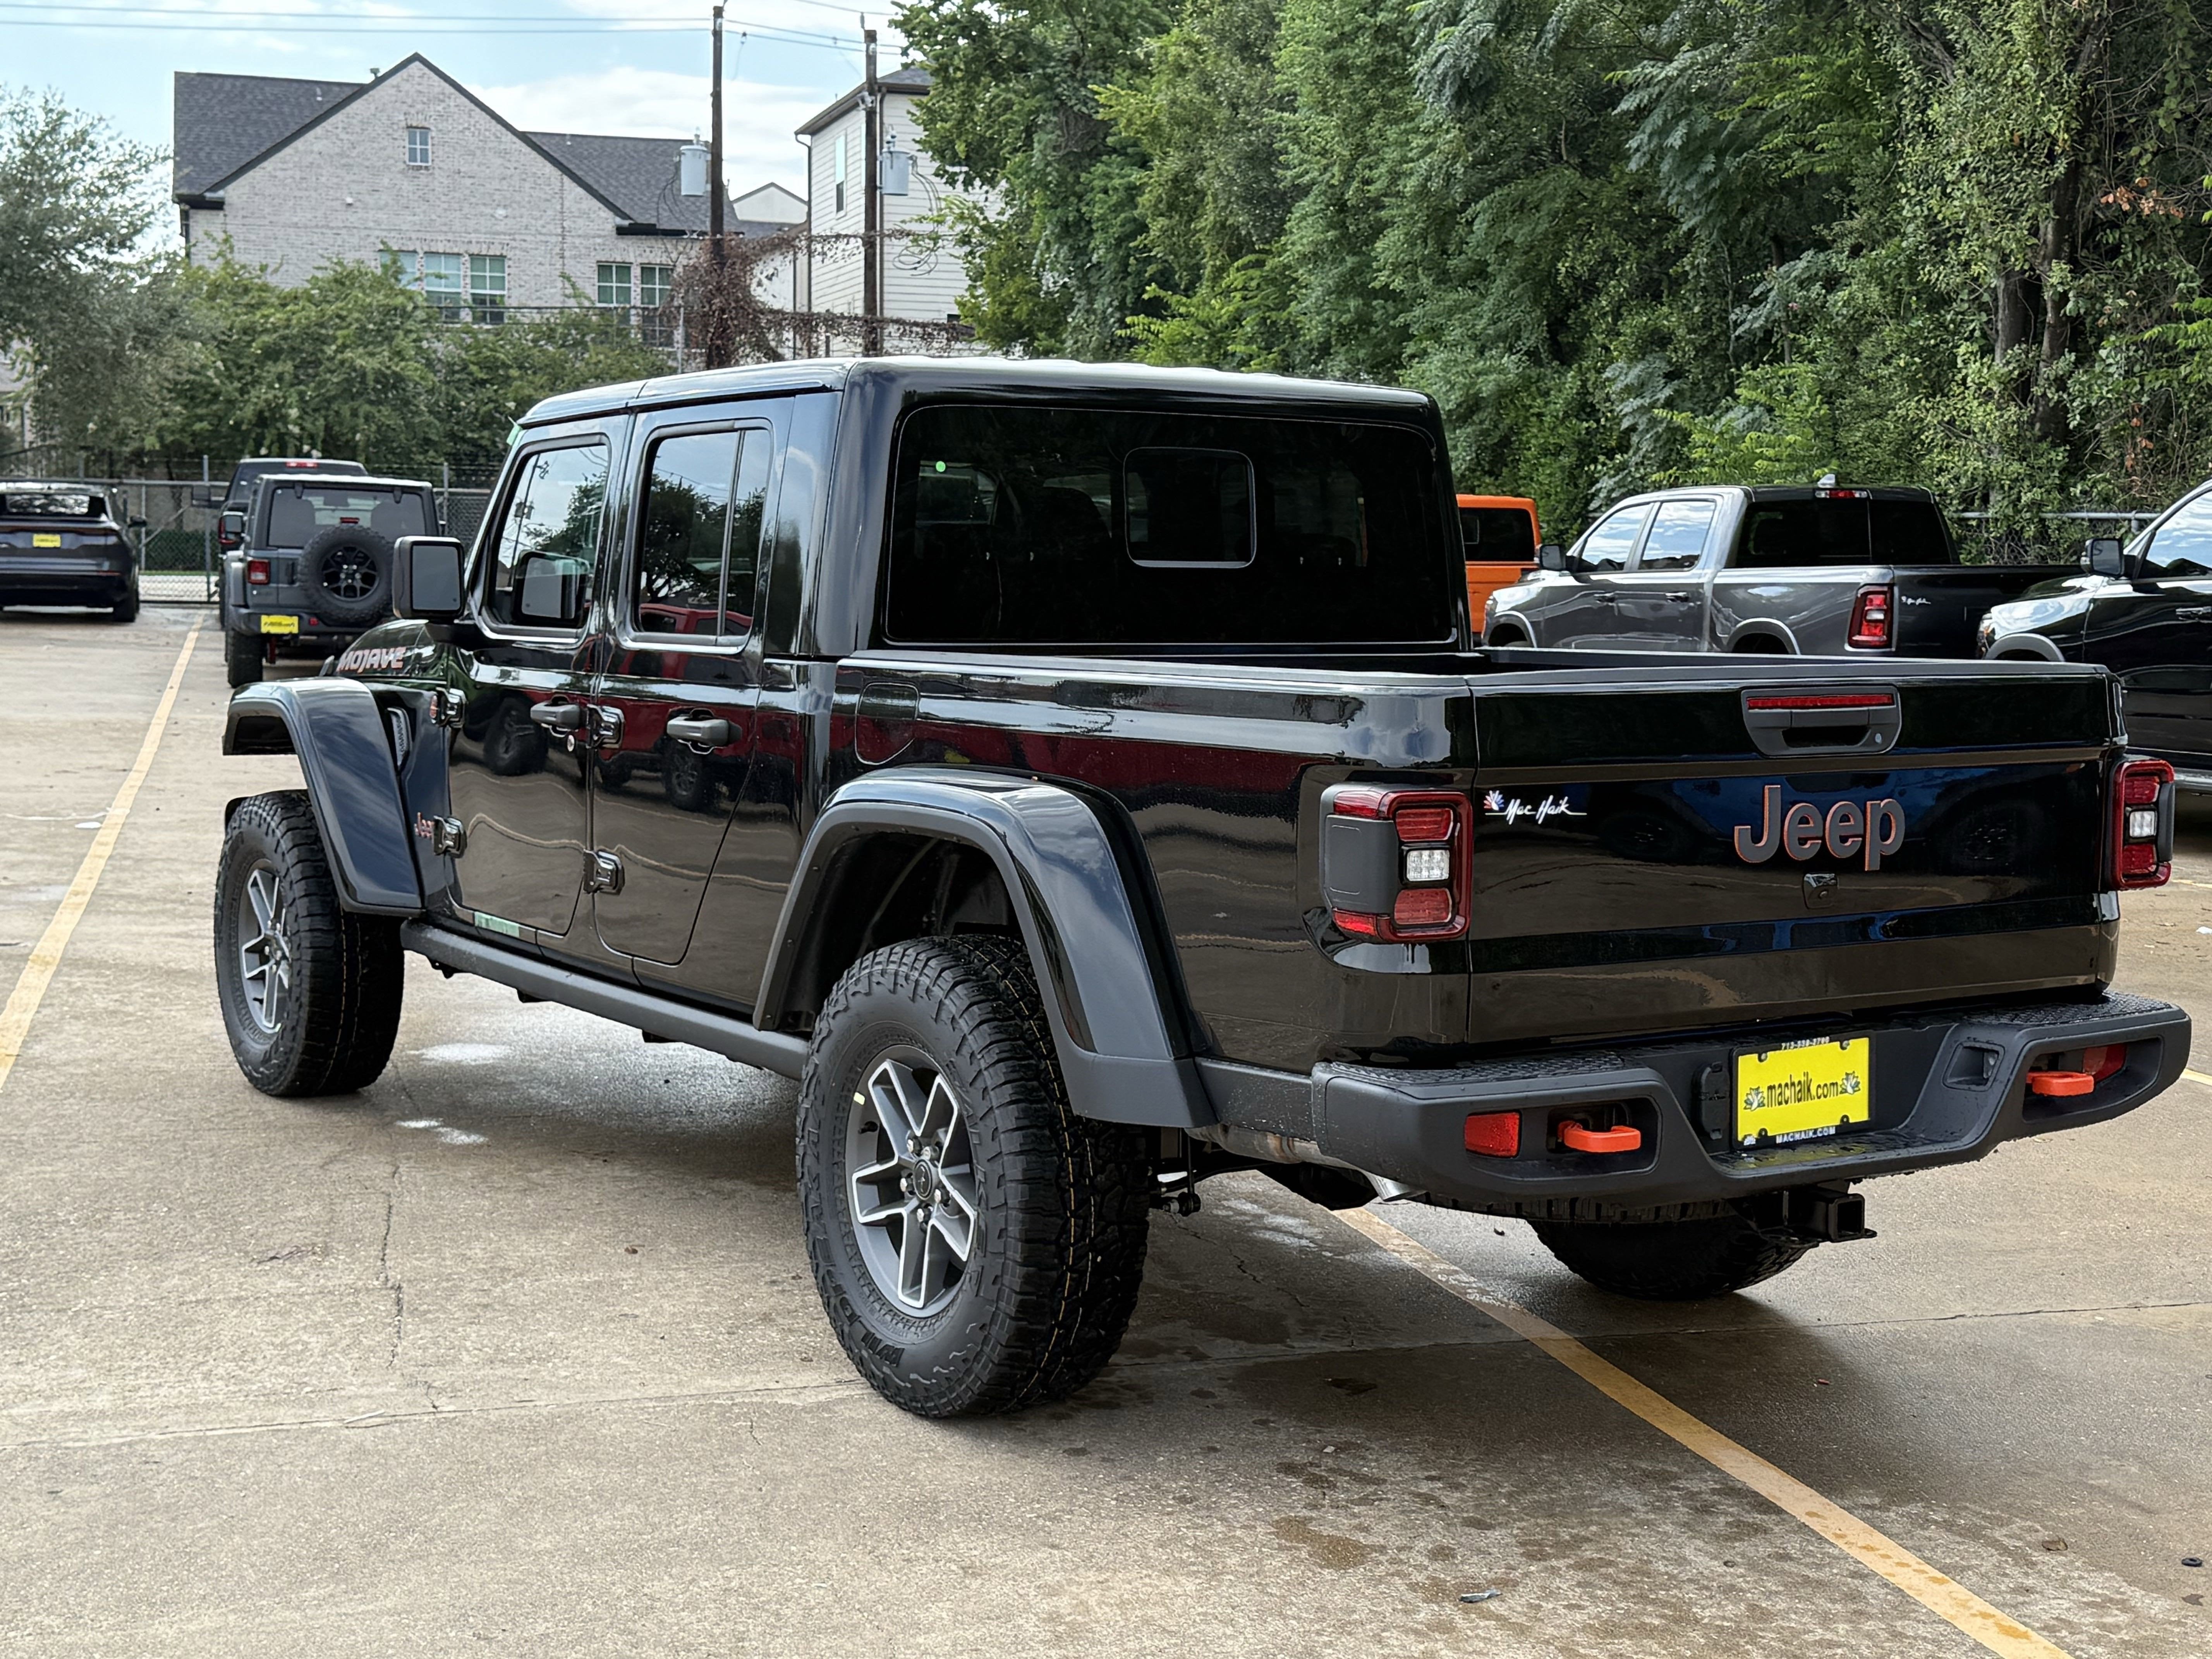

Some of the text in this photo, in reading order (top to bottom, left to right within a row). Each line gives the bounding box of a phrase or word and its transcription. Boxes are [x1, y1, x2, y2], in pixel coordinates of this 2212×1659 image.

[337, 646, 406, 673] MOJAVE
[1501, 795, 1576, 824] Mac Haik
[414, 812, 434, 838] Jee
[1734, 785, 1905, 871] Jeep
[1767, 1072, 1838, 1108] machaik.com
[1776, 1126, 1836, 1144] MACHAIK.COM
